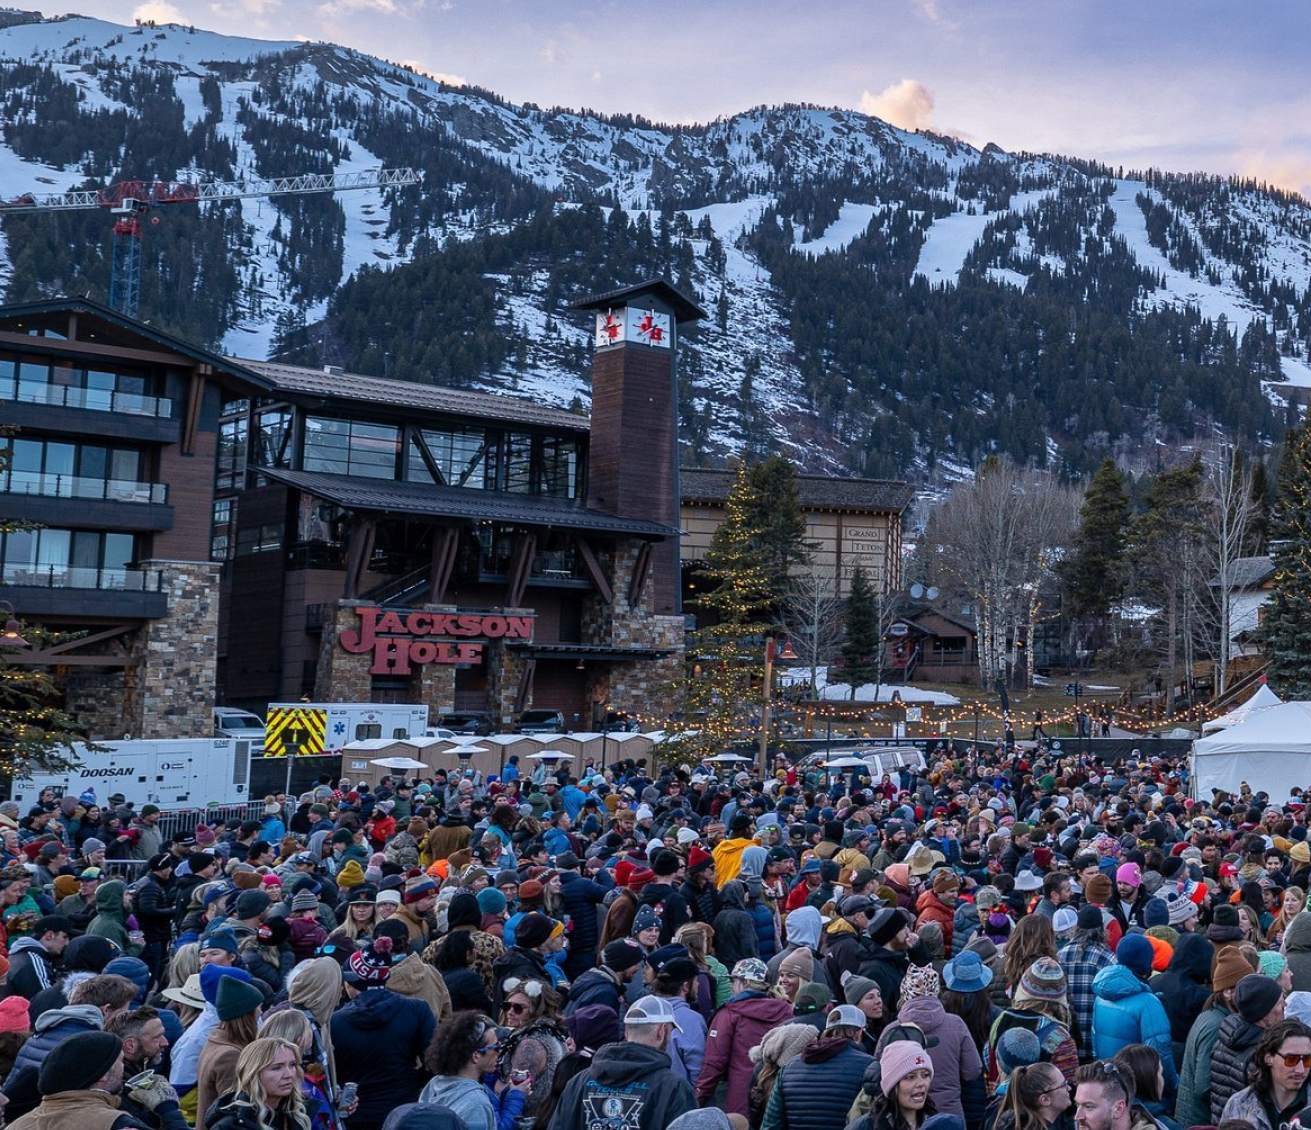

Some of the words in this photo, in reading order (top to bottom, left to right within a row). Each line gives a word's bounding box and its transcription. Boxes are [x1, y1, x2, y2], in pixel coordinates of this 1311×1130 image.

[340, 607, 534, 653] JACKSON
[370, 637, 483, 675] HOLE
[80, 767, 135, 778] DOOSAN
[352, 957, 379, 979] USA
